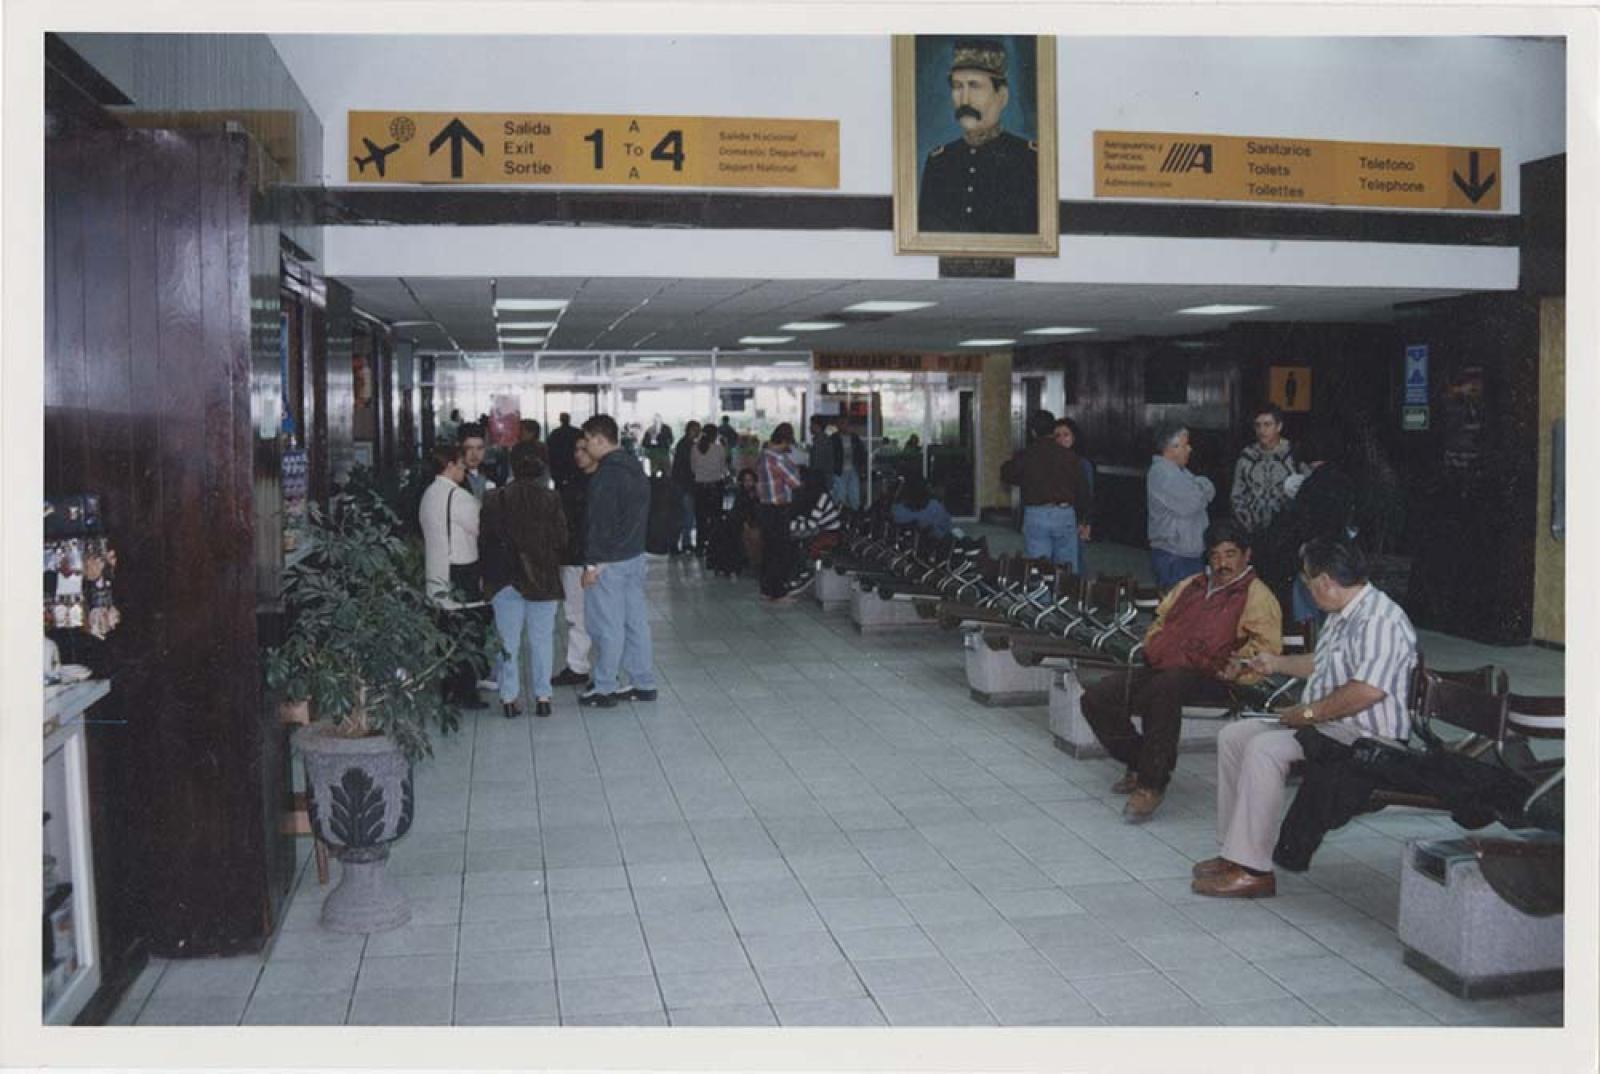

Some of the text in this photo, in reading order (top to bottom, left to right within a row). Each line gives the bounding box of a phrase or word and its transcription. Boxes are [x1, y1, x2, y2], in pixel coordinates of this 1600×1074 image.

[504, 121, 551, 135] Salida
[628, 120, 640, 132] A
[504, 141, 534, 155] Exit
[584, 128, 686, 171] 1 To 4
[1247, 142, 1312, 157] Sanitarios
[504, 161, 552, 175] Sortie
[628, 167, 640, 179] A
[1248, 163, 1290, 176] Toilets
[1248, 184, 1304, 198] Toilettes
[1359, 177, 1425, 193] Telephone
